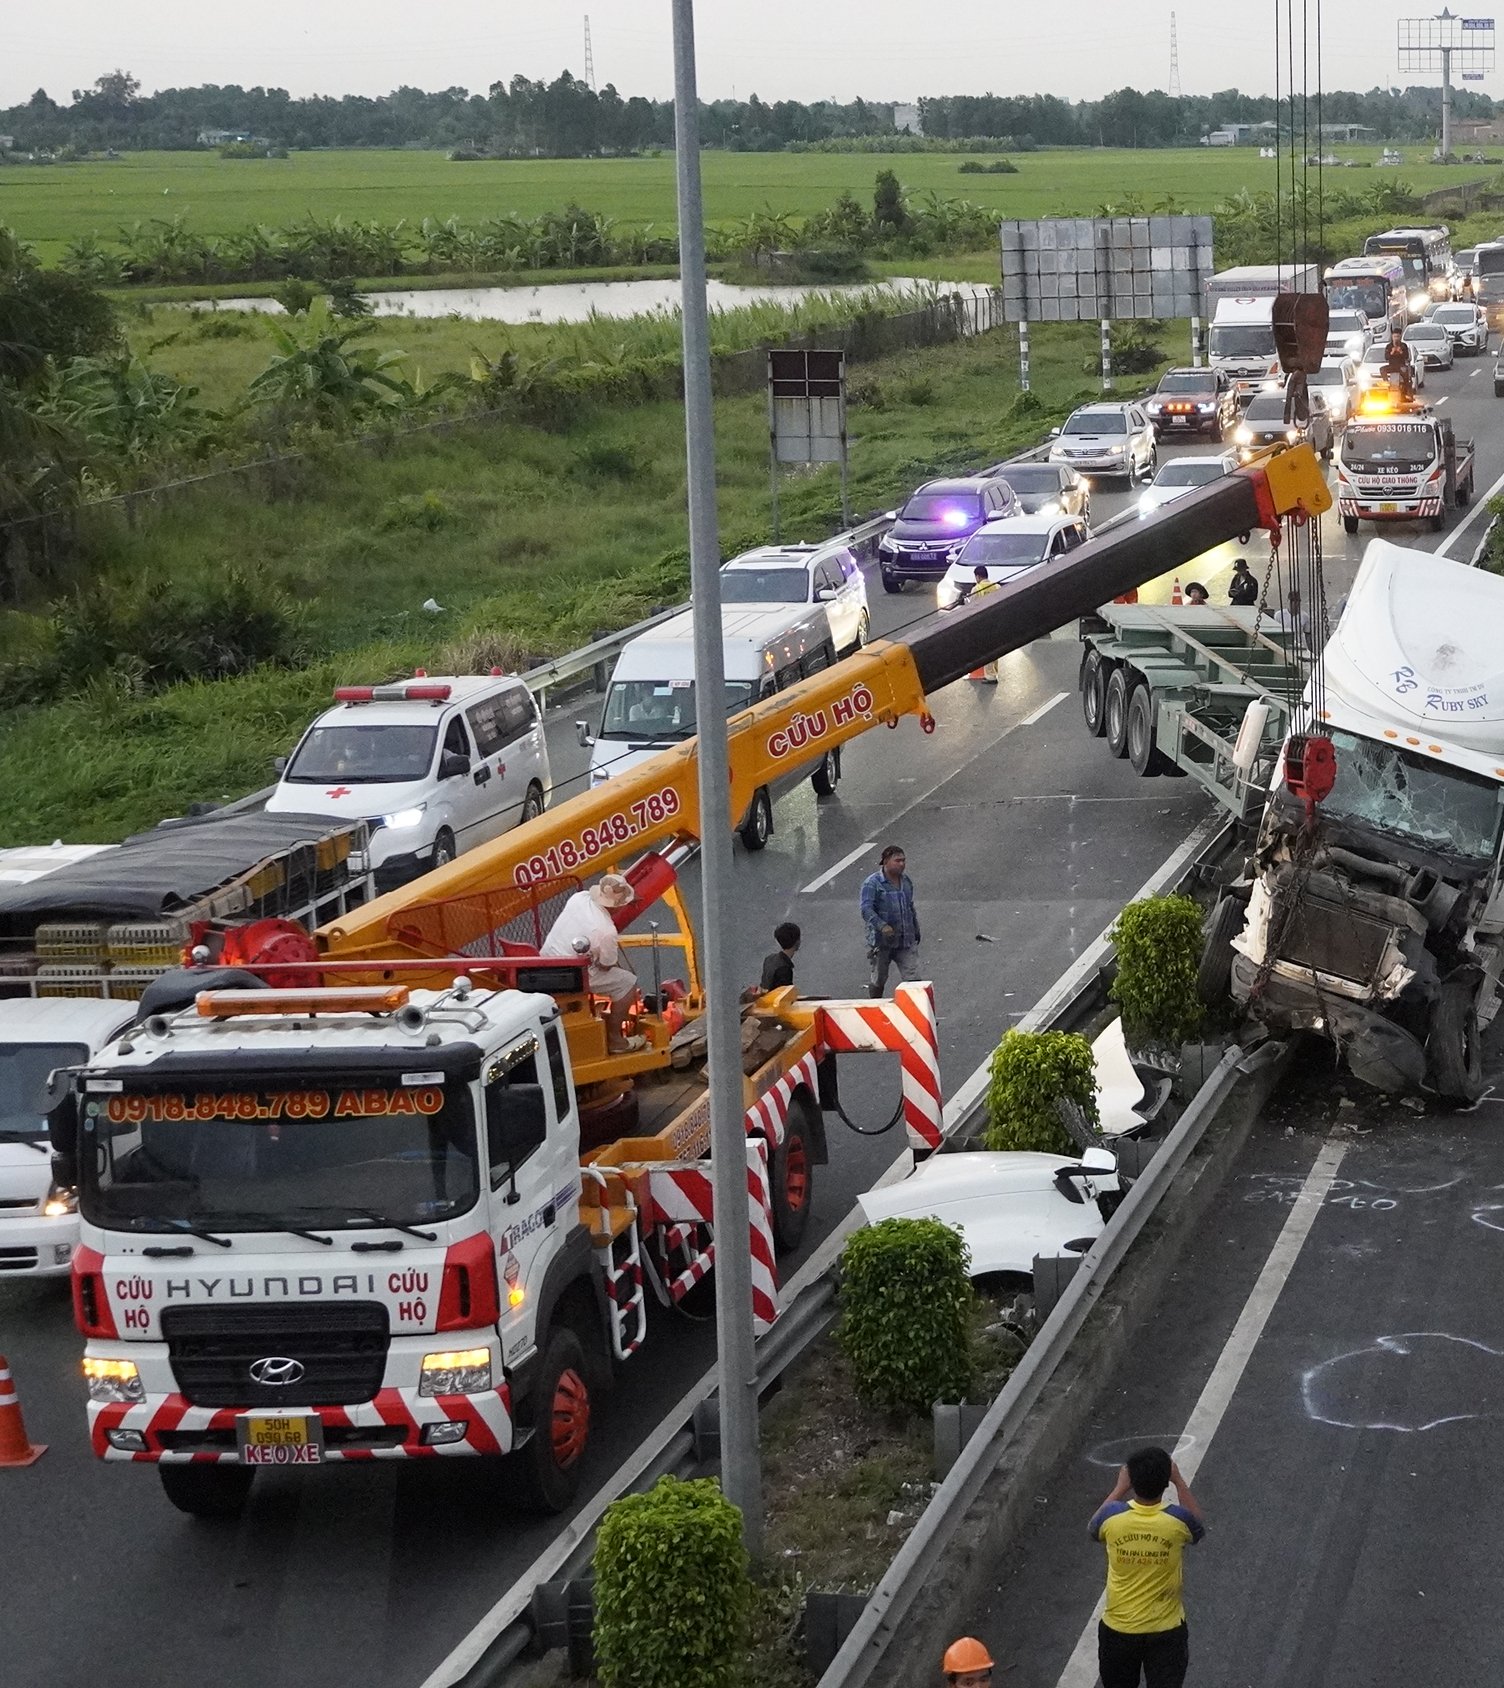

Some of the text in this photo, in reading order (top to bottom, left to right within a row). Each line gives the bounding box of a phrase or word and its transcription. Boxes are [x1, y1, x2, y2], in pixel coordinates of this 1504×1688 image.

[1377, 424, 1396, 433] 0933
[1397, 425, 1411, 433] 016
[1413, 425, 1427, 433] 116
[1467, 694, 1489, 710] SKY
[767, 681, 874, 758] CỨU HỘ
[513, 786, 681, 892] 0918.848.789
[108, 1088, 330, 1122] 0918.848.789
[116, 1267, 429, 1300] CỨU HYUNDAI CỨU
[124, 1307, 150, 1334] HỘ
[399, 1297, 427, 1326] HỘ
[264, 1418, 290, 1431] 50H
[291, 1443, 321, 1464] XE
